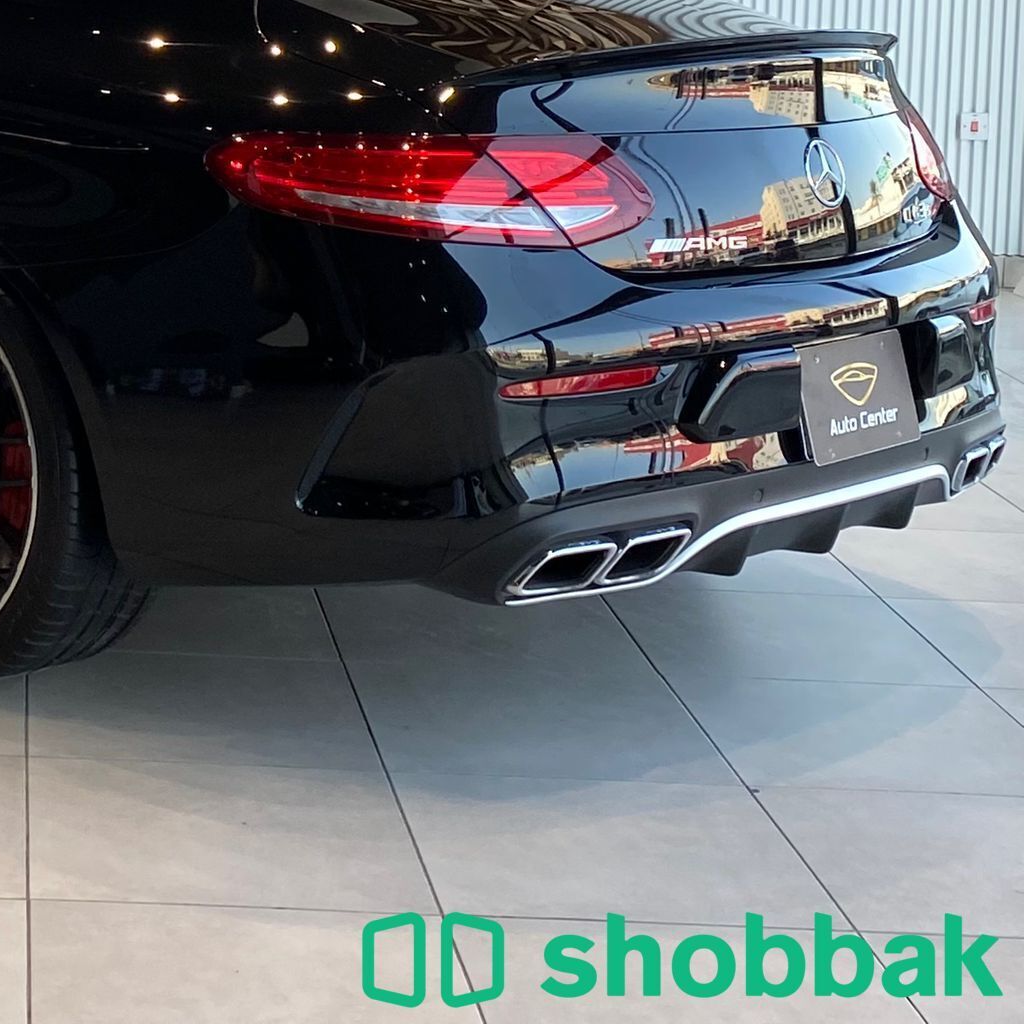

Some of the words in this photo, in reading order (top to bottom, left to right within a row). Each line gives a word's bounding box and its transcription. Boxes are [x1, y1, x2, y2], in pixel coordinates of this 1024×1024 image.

[682, 236, 748, 251] AMG
[830, 415, 858, 437] Auto
[860, 406, 899, 429] Center
